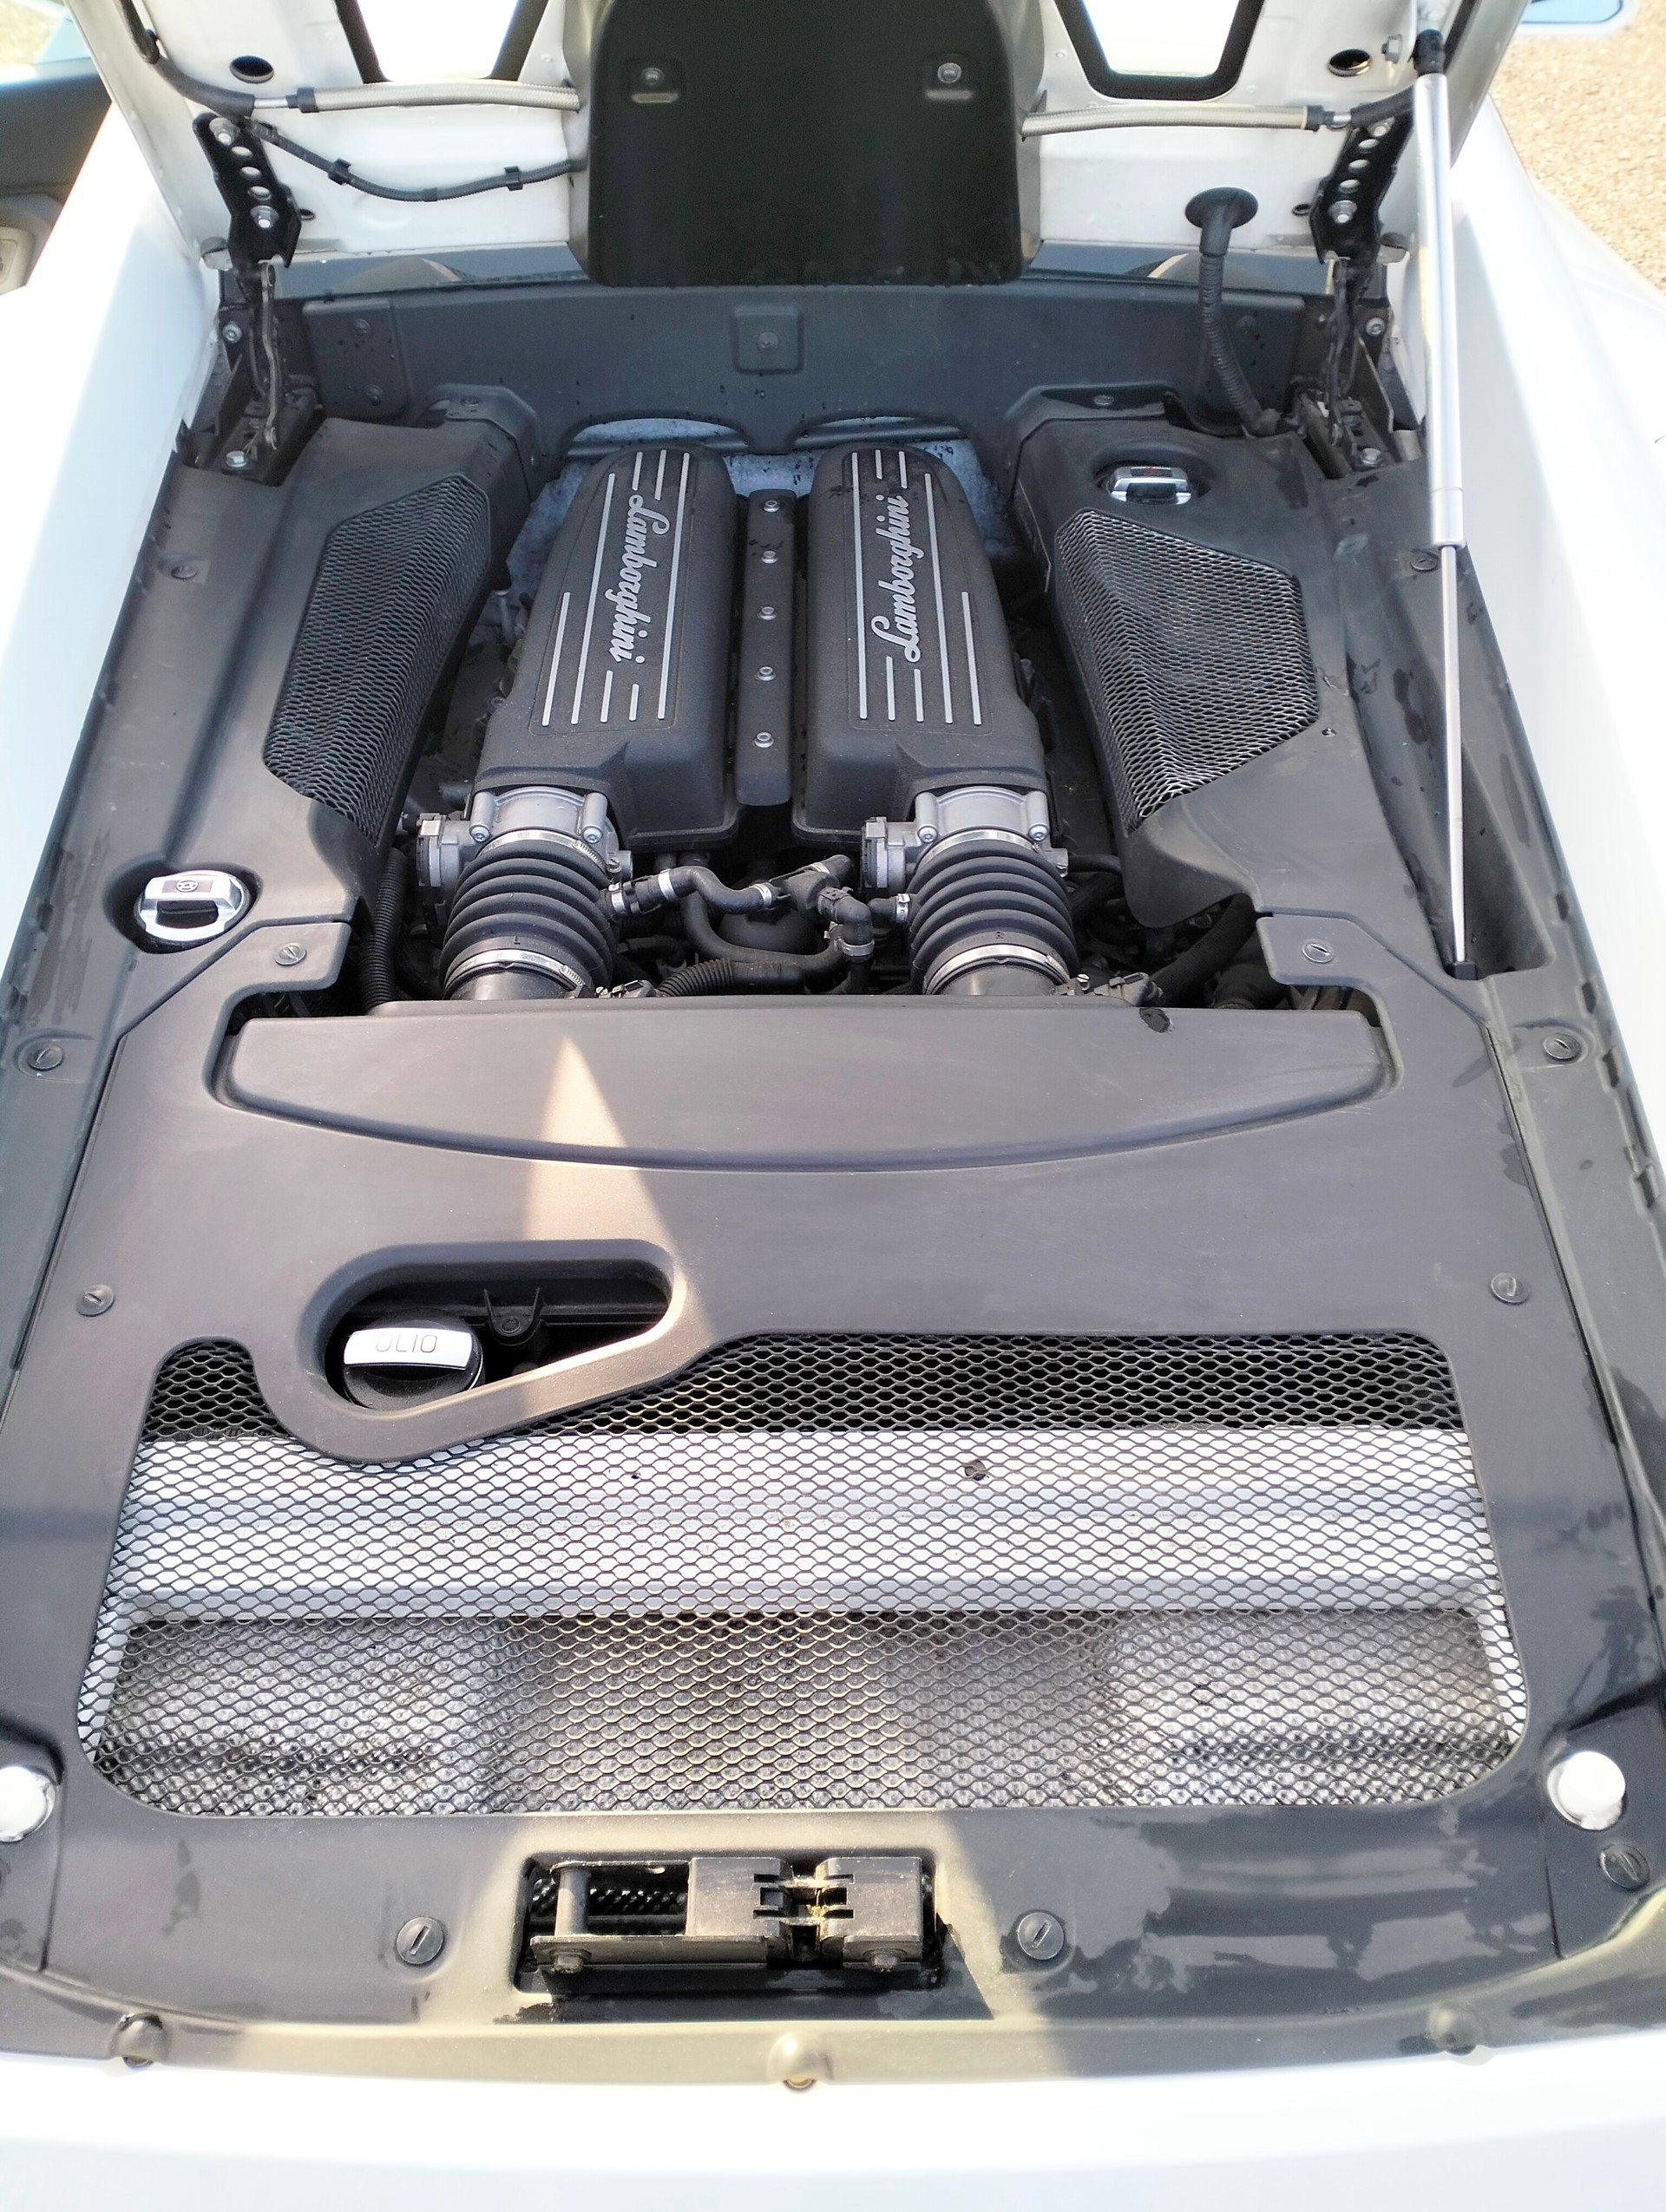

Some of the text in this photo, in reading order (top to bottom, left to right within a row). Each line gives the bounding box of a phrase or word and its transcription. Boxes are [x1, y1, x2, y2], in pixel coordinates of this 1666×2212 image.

[605, 494, 670, 663] Lamborghini
[870, 494, 924, 663] Lamborghini
[376, 1333, 438, 1353] OLIO
